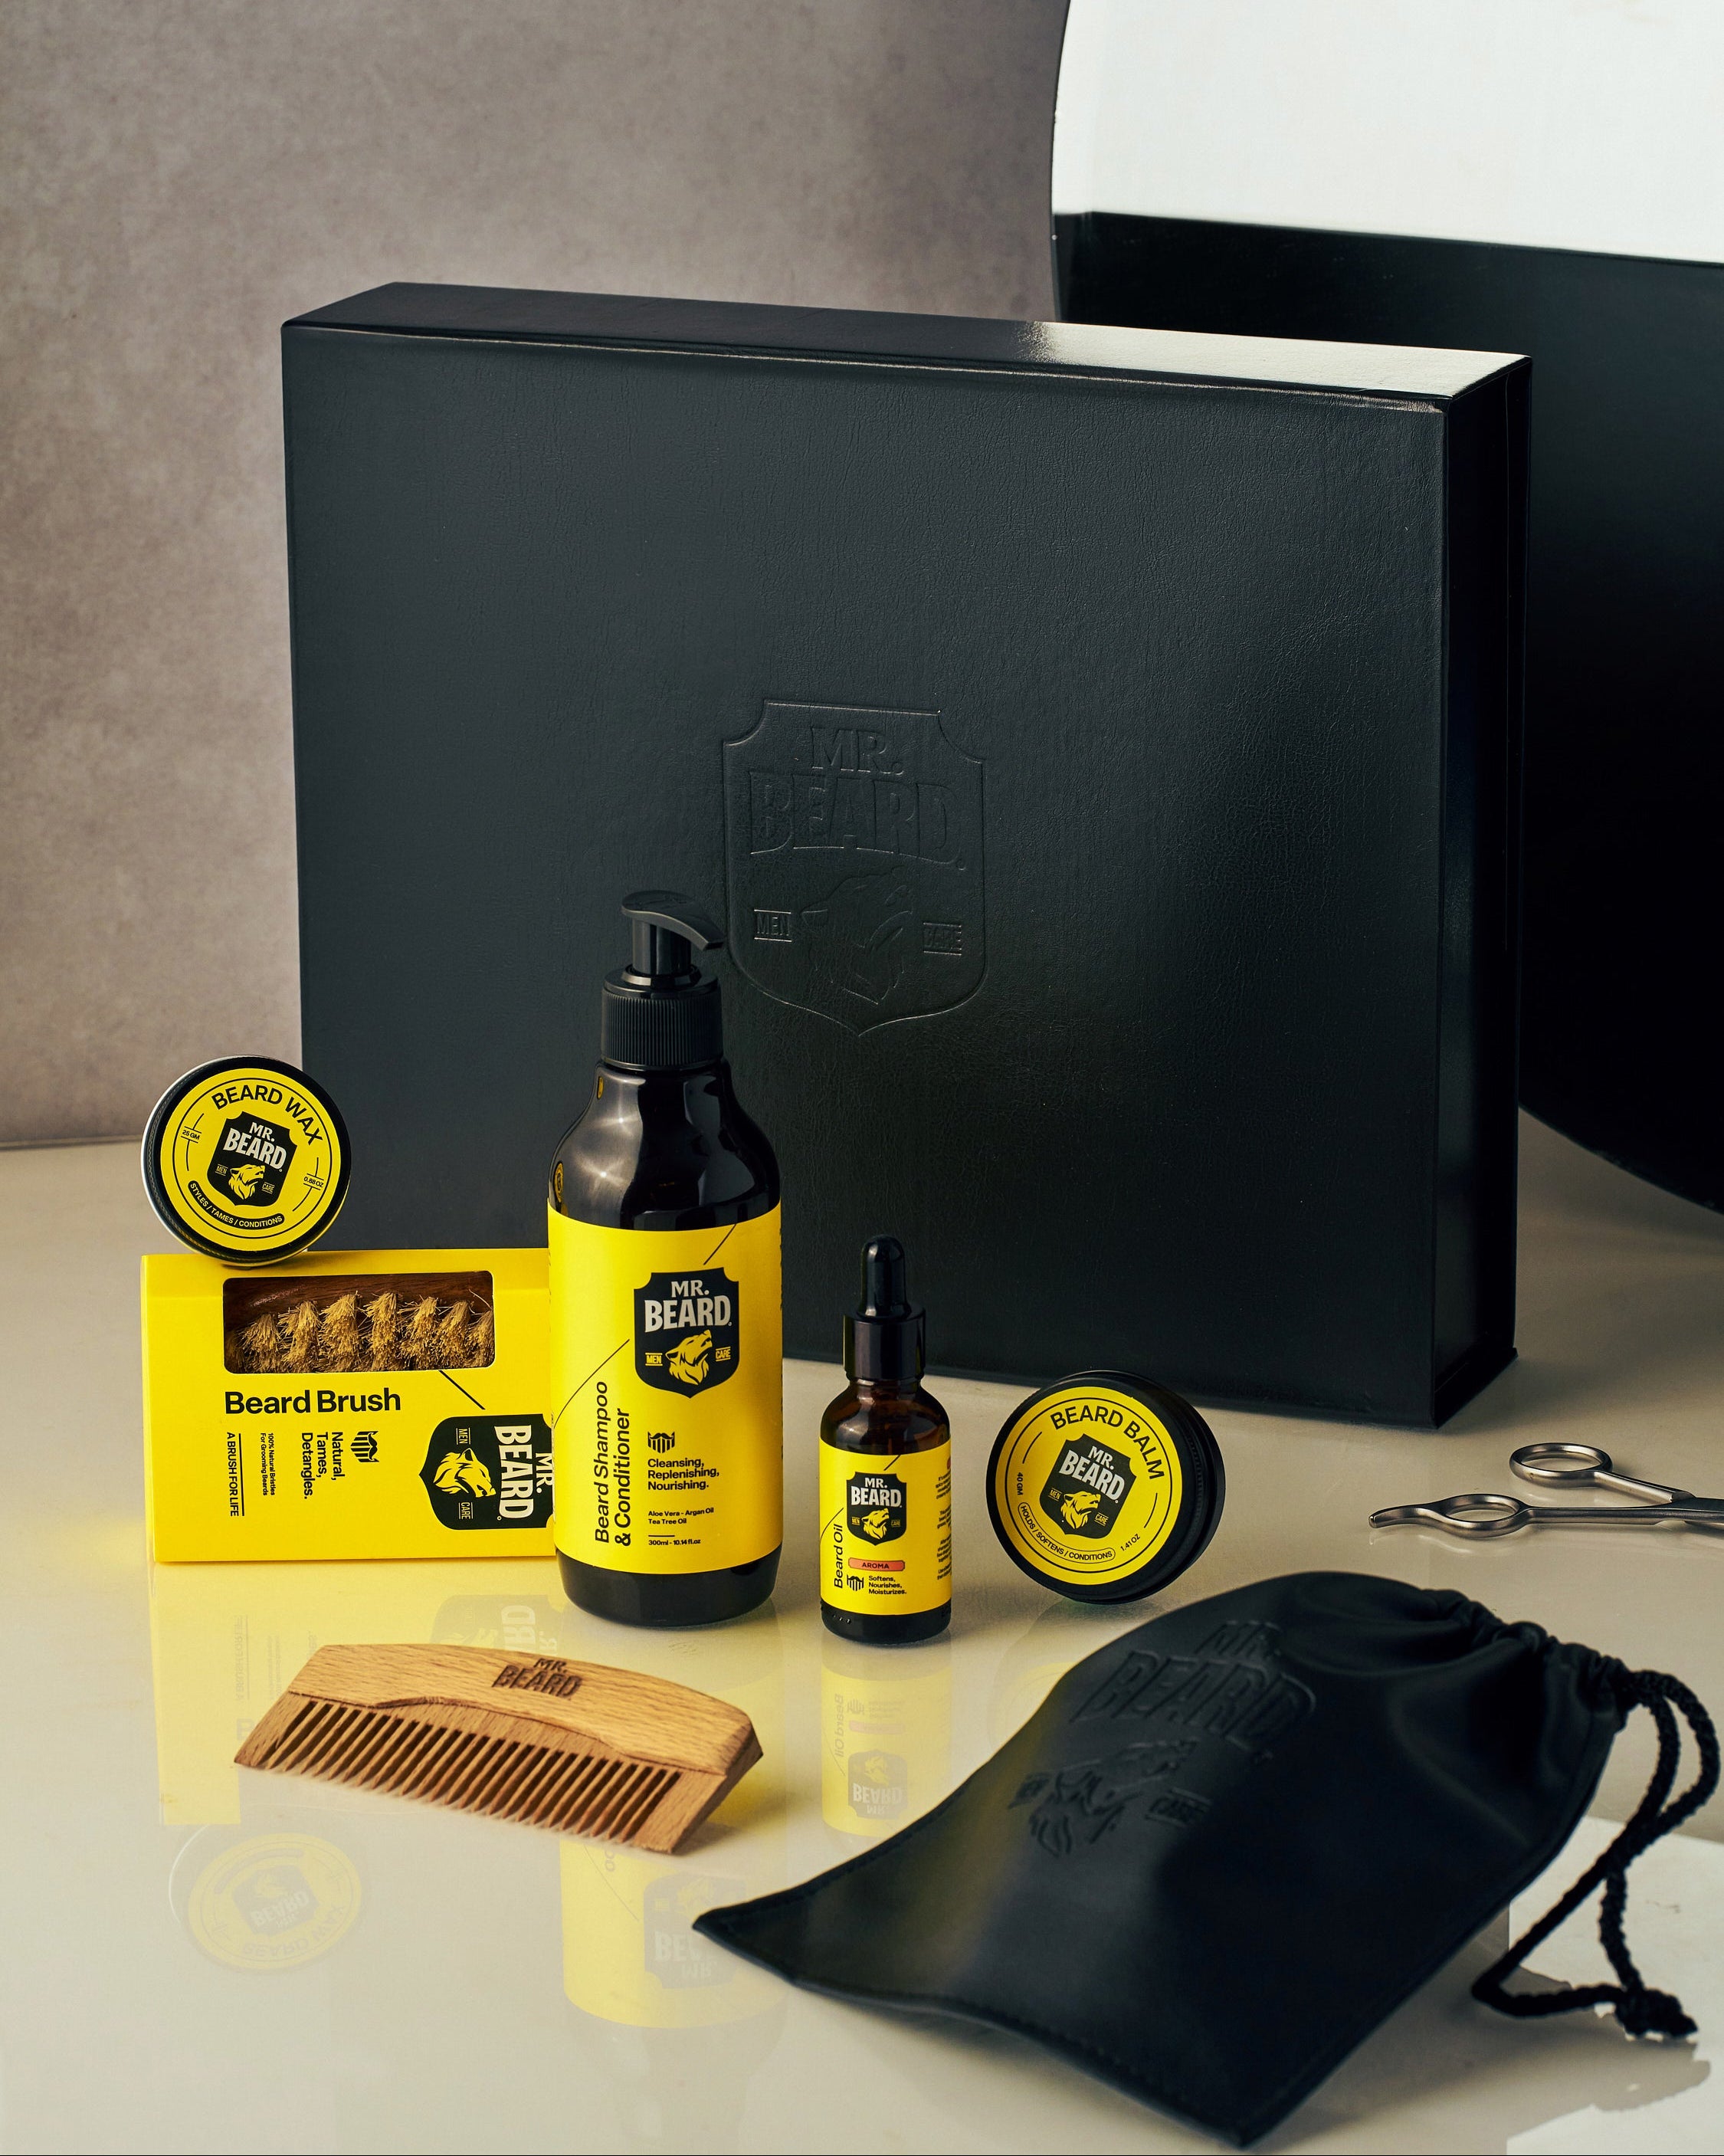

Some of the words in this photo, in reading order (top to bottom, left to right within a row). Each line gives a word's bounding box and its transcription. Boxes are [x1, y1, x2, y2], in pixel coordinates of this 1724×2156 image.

[810, 727, 904, 776] MR.
[749, 771, 959, 865] BEARD
[755, 915, 790, 937] MEN
[211, 1085, 282, 1110] BEARD
[285, 1097, 323, 1146] WAX
[190, 1132, 200, 1140] GM
[248, 1121, 275, 1142] MR.
[223, 1127, 287, 1170] BEARD
[215, 1165, 228, 1175] MEN
[262, 1183, 275, 1193] CARE
[303, 1176, 316, 1186] 0.88
[190, 1183, 209, 1207] STYLES
[211, 1207, 234, 1224] TAMES
[238, 1216, 283, 1228] CONDITIONS
[671, 1279, 710, 1298] MR.
[644, 1295, 731, 1333] BEARD
[646, 1354, 662, 1364] MEN
[716, 1348, 731, 1360] CARE
[225, 1389, 311, 1415] Beard
[316, 1387, 402, 1413] Brush
[458, 1428, 468, 1444] MEN
[594, 1381, 611, 1479] Shampoo
[1050, 1405, 1123, 1430] BEARD
[1123, 1420, 1165, 1480] BALM
[228, 1441, 238, 1475] BRUSH
[316, 1431, 329, 1478] Tames,
[331, 1431, 346, 1481] Natural,
[647, 1457, 705, 1469] Cleansing,
[1087, 1445, 1115, 1470] MR.
[300, 1432, 316, 1500] Detangles.
[494, 1425, 534, 1519] BEARD
[535, 1452, 553, 1494] MR.
[613, 1408, 631, 1528] Conditioner
[647, 1467, 719, 1481] Replenishing,
[1059, 1449, 1126, 1501] BEARD
[228, 1475, 238, 1496] FOR
[647, 1480, 710, 1491] Nourishing.
[864, 1477, 888, 1488] MR.
[1017, 1472, 1023, 1483] 40
[851, 1485, 902, 1508] BEARD
[1016, 1483, 1023, 1495] GM
[1049, 1488, 1060, 1500] MEN
[230, 1497, 239, 1517] LIFE
[460, 1501, 471, 1520] CARE
[595, 1482, 609, 1544] Beard
[1094, 1514, 1109, 1525] CARE
[615, 1531, 631, 1547] &
[833, 1523, 844, 1543] Oil
[1020, 1505, 1036, 1531] HOLDS
[1037, 1531, 1064, 1554] SOFTENS
[1068, 1551, 1113, 1561] CONDITIONS
[1120, 1540, 1132, 1551] 1.41
[1130, 1533, 1141, 1544] OZ
[834, 1544, 844, 1589] Beard
[533, 1657, 568, 1674] MR.
[491, 1664, 583, 1698] BEARD
